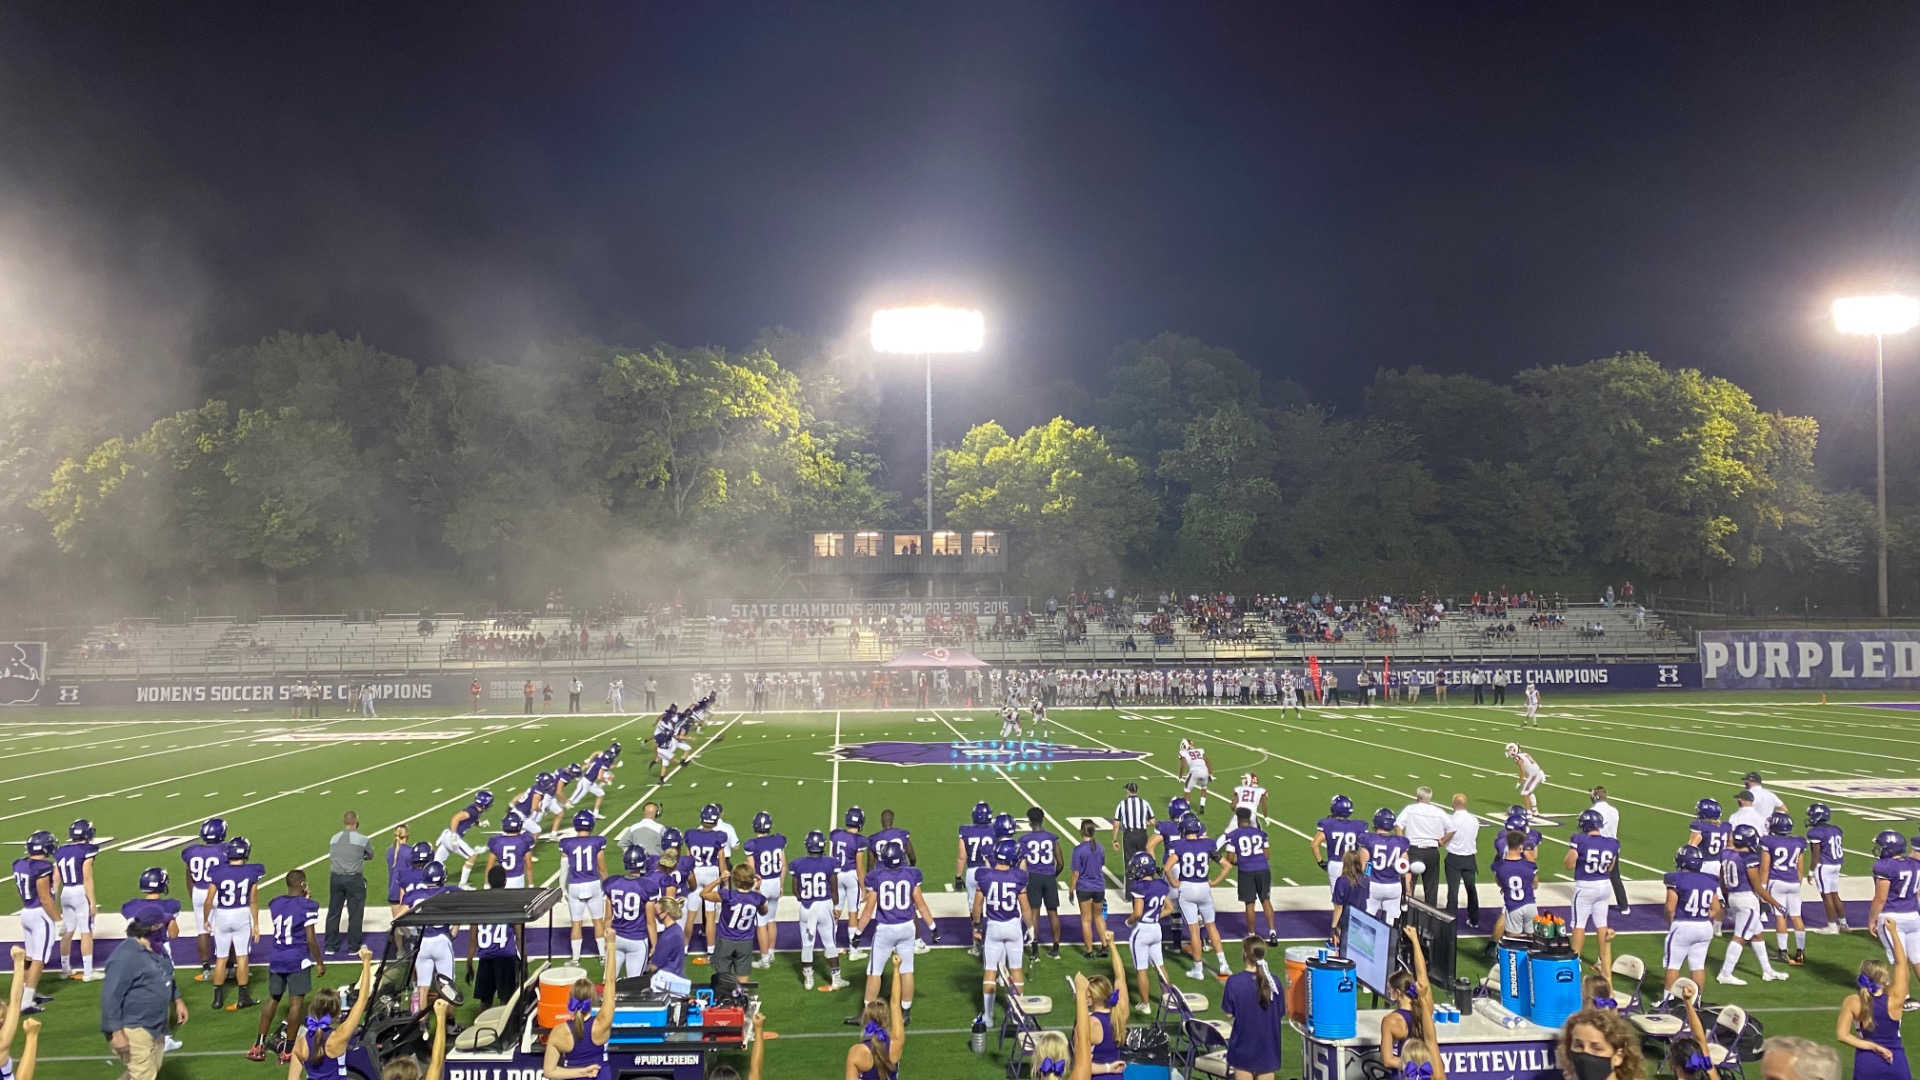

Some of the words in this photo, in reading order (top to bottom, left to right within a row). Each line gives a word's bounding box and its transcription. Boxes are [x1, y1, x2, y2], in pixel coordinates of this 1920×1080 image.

[731, 603, 778, 618] STATE
[782, 603, 863, 618] CHAMPIONS
[925, 601, 951, 616] 2012
[984, 601, 1009, 614] 2016
[1526, 668, 1608, 685] CHAMPIONS
[136, 686, 206, 702] WOMEN'S
[210, 685, 274, 701] SOCCER
[1189, 751, 1203, 760] 92
[1241, 789, 1256, 803] 21
[1027, 839, 1054, 865] 33
[1238, 835, 1264, 857] 92
[1331, 831, 1357, 857] 78
[1708, 832, 1728, 855] 51
[1828, 835, 1844, 860] 18
[58, 856, 77, 884] 11
[501, 845, 517, 871] 5
[572, 845, 594, 872] 11
[759, 848, 782, 876] 80
[1181, 851, 1210, 879] 83
[1584, 848, 1613, 874] 56
[1773, 847, 1800, 871] 24
[800, 872, 827, 900] 56
[1721, 859, 1739, 888] 10
[220, 878, 250, 907] 31
[879, 879, 911, 911] 60
[986, 881, 1017, 912] 45
[1508, 875, 1525, 901] 8
[611, 889, 641, 921] 59
[1684, 888, 1714, 917] 49
[273, 914, 293, 945] 11
[728, 902, 757, 931] 18
[477, 923, 508, 949] 84
[1509, 953, 1518, 997] POWERADE
[634, 1054, 700, 1067] #PURPLEREIGN
